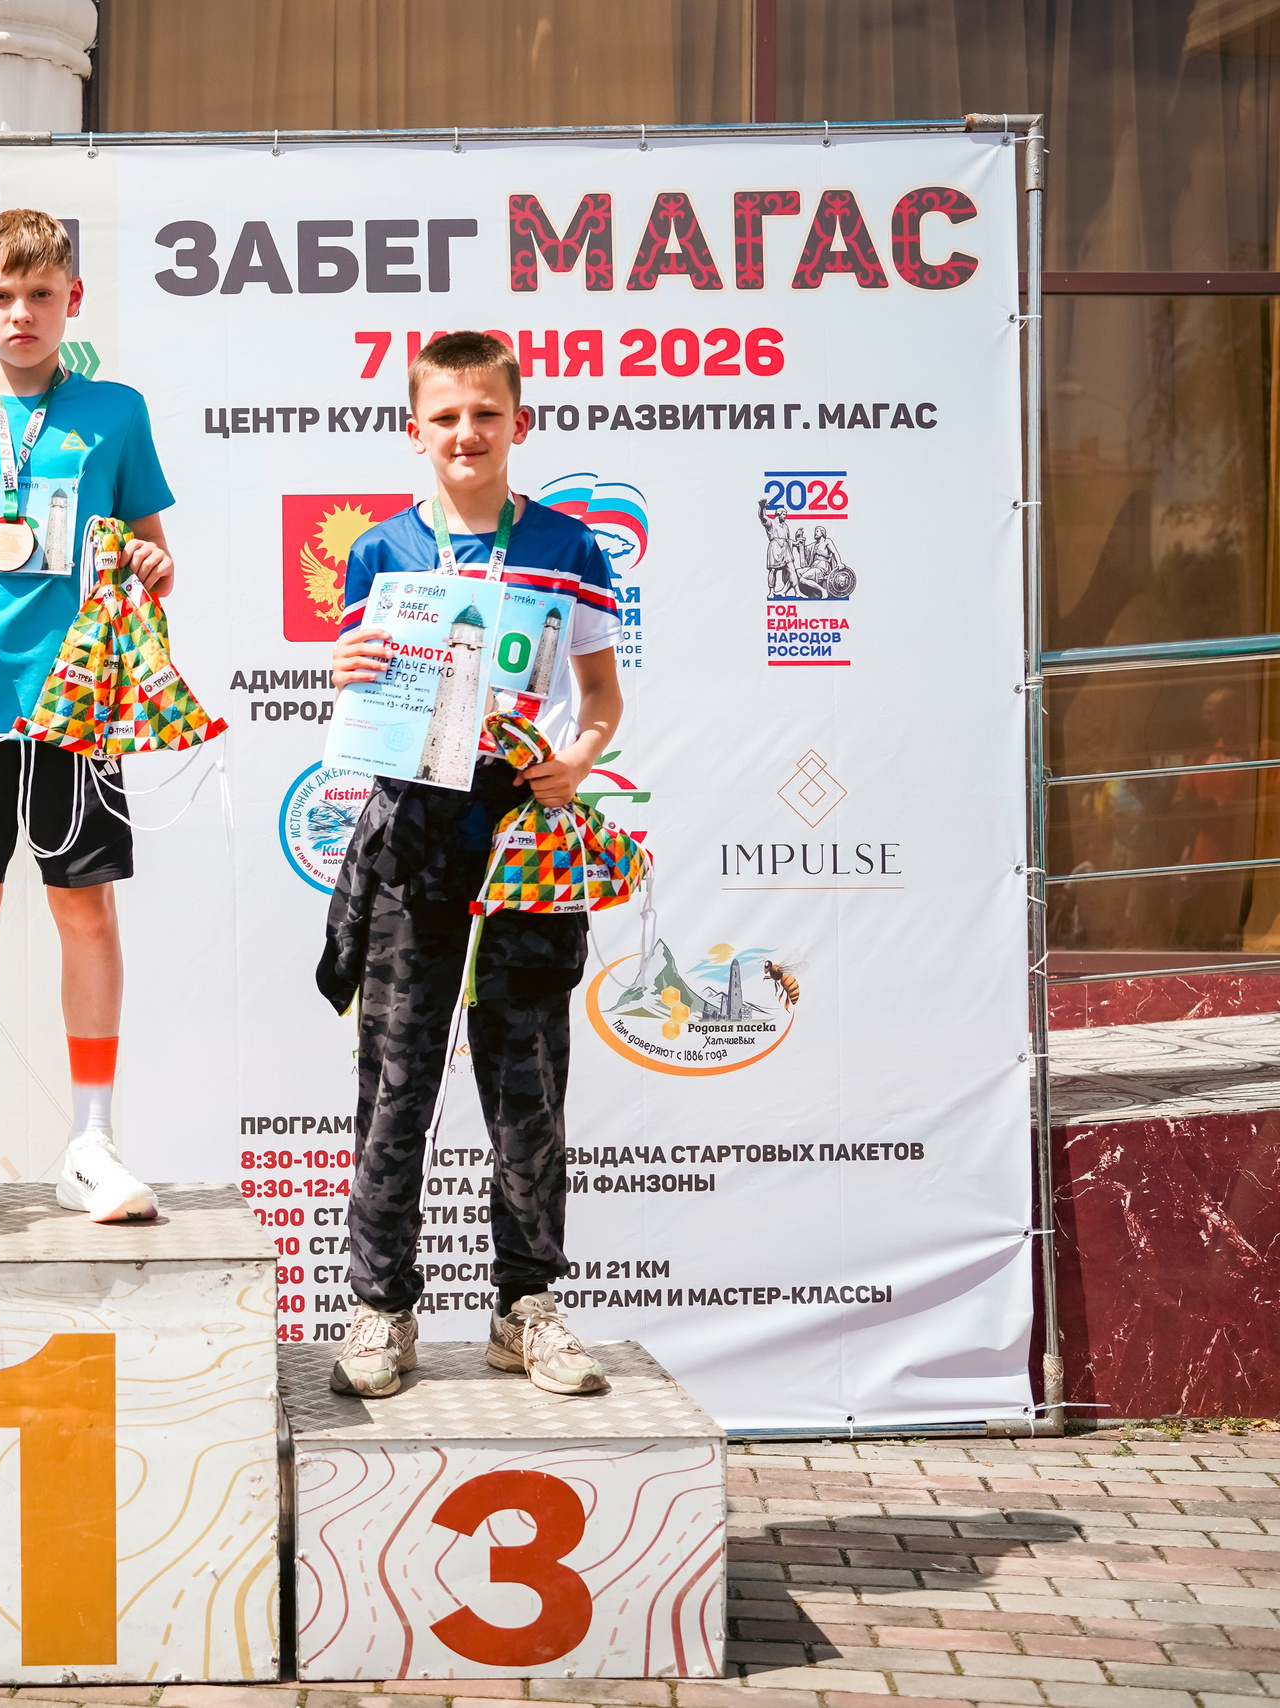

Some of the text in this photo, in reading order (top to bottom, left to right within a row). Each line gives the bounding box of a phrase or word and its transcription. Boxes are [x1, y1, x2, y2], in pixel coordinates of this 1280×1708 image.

[154, 187, 980, 296] ЗАБЕГ МАГАС
[354, 331, 392, 378] 7
[620, 328, 786, 377] 2026
[205, 407, 320, 437] ЦЕНТР
[588, 402, 777, 431] РАЗВИТИЯ
[783, 402, 809, 430] Г.
[819, 401, 939, 431] МАГАС
[764, 480, 849, 511] 2026
[400, 601, 429, 611] ЗАБЕГ
[767, 605, 798, 617] ГОД
[397, 610, 440, 624] МАГАС
[767, 618, 850, 631] ЕДИНСТВА
[767, 632, 841, 645] НАРОДОВ
[767, 645, 832, 657] РОССИИ
[385, 669, 418, 683] ЕГОР
[290, 782, 316, 839] ИСТОЧНИК
[721, 843, 902, 875] IMPULSE
[687, 1022, 777, 1036] Родовая пасека
[613, 1019, 630, 1038] Нам
[628, 1035, 675, 1060] доверяют
[684, 1050, 704, 1061] 1886
[705, 1049, 728, 1061] года
[702, 1035, 756, 1049] Хамчиевых
[241, 1116, 357, 1135] ПРОГРАМ
[241, 1142, 925, 1169] 8:30-10:0 ВЫДАЧА СТАРТОВЫХ ПАКЕТОВ
[593, 1173, 716, 1193] ФАНЗОНЫ
[458, 1235, 489, 1255] 1,5
[586, 1262, 601, 1279] И
[606, 1261, 629, 1279] 21
[636, 1261, 670, 1278] КМ
[553, 1290, 662, 1308] РОГРАММ
[667, 1289, 682, 1306] И
[688, 1285, 893, 1306] МАСТЕР-КЛАССЫ
[430, 1470, 593, 1668] 3
